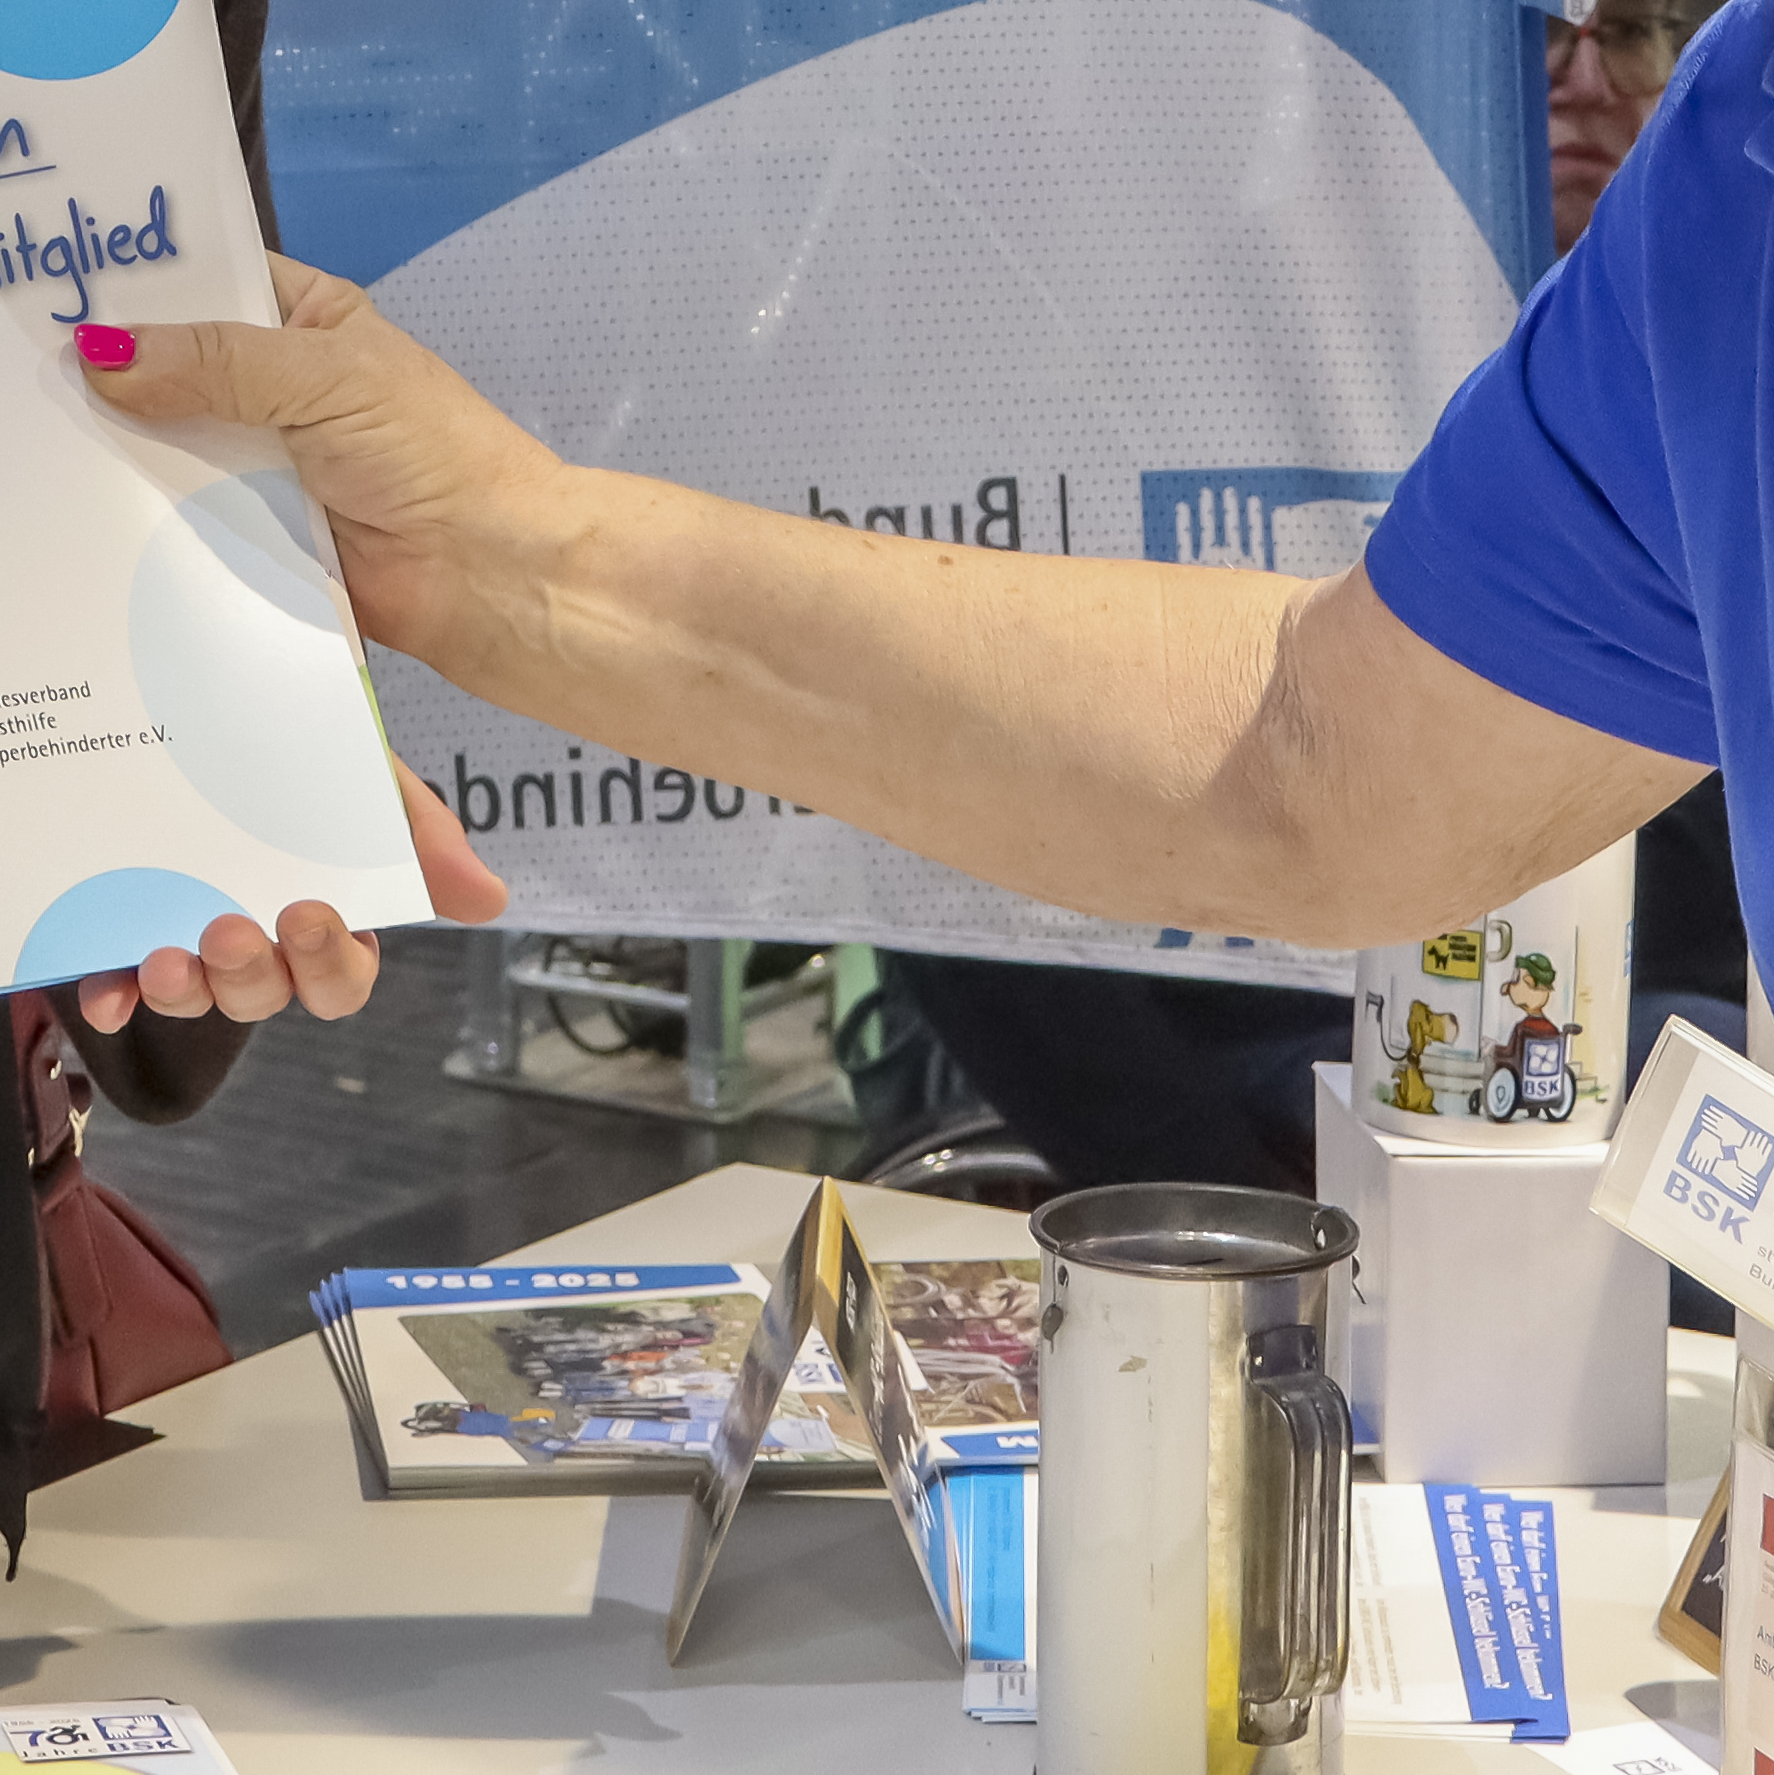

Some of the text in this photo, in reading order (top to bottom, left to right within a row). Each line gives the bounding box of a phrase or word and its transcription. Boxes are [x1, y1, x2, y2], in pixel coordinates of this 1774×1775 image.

[138, 724, 174, 746] e.V.
[1524, 1079, 1560, 1098] BSK
[1662, 1170, 1751, 1245] BSK
[384, 1273, 494, 1290] 1955
[530, 1271, 640, 1289] 2025
[1753, 1652, 1774, 1681] BSK
[106, 1737, 182, 1754] BSK
